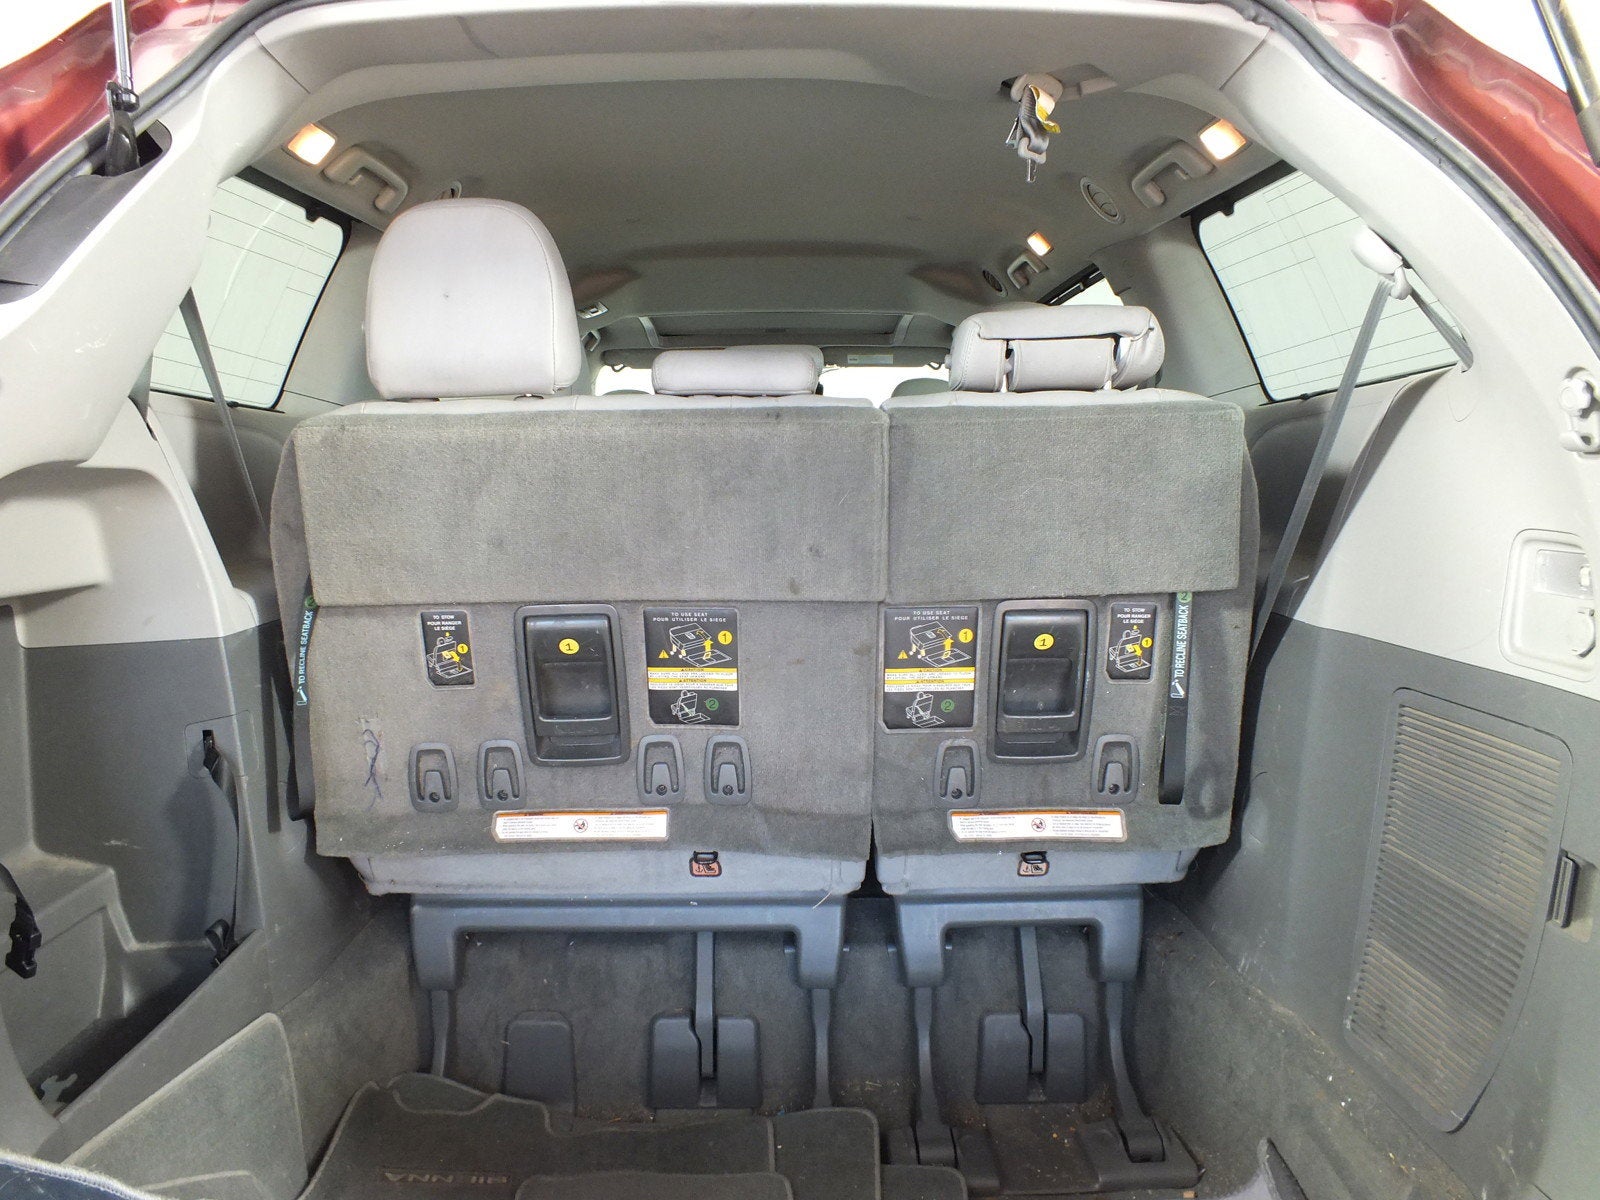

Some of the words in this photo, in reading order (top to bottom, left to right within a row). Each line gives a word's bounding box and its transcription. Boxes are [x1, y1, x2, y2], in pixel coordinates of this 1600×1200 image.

[300, 610, 314, 645] SEATBACK
[1177, 604, 1189, 640] SEATBACK
[299, 645, 307, 675] RECLINE
[1175, 641, 1187, 669] RECLINE
[298, 675, 306, 685] TO
[1174, 669, 1185, 678] TO
